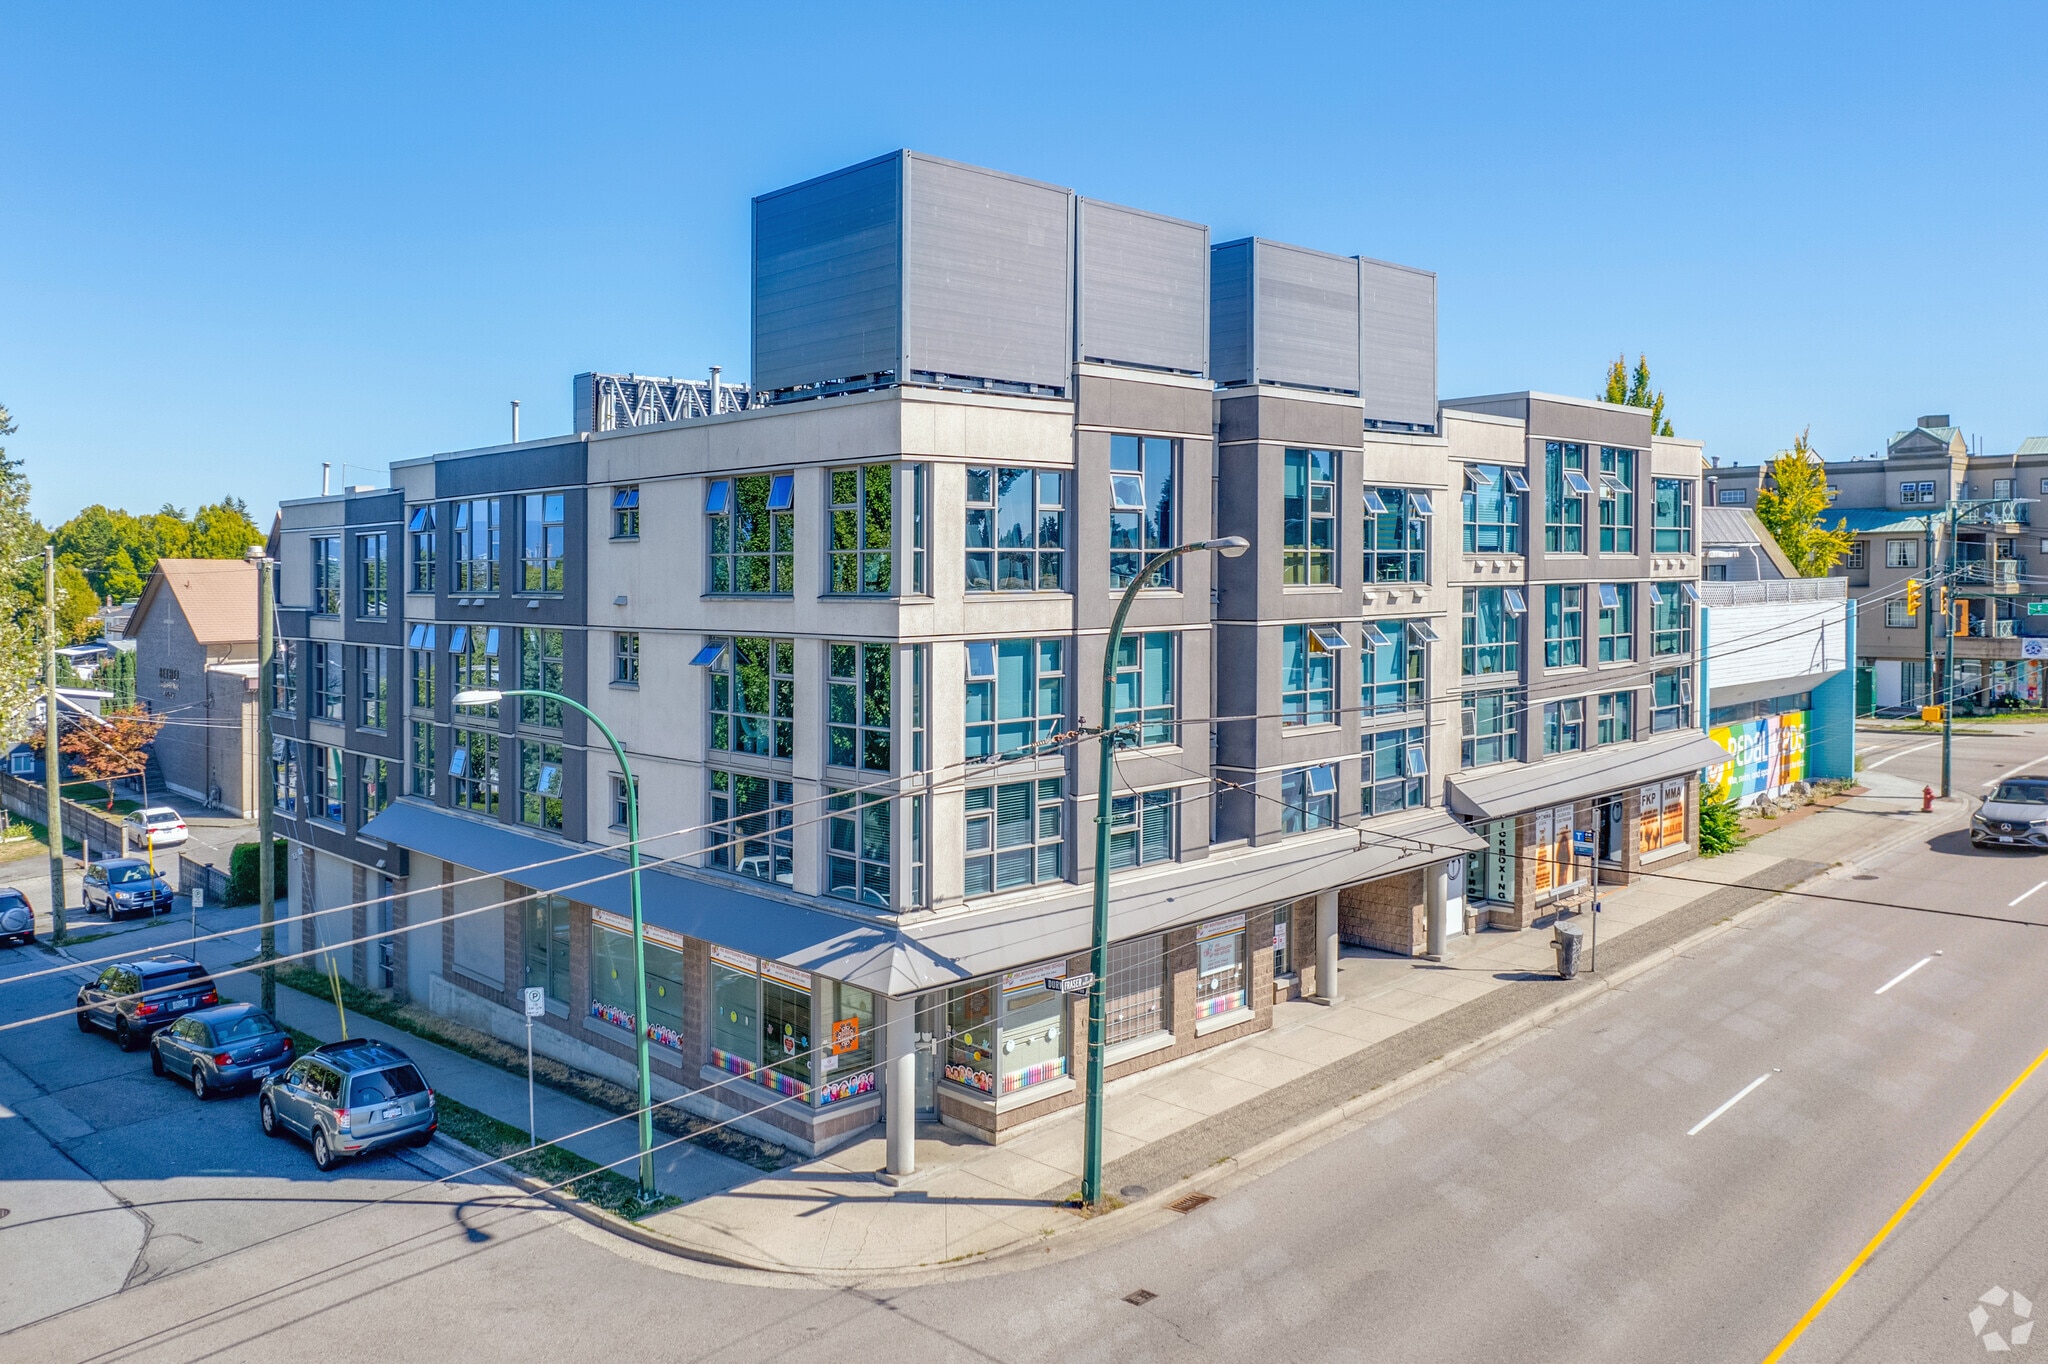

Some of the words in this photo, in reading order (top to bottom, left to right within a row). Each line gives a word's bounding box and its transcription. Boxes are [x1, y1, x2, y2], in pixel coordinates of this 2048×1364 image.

[1642, 792, 1656, 806] FKP
[1664, 786, 1682, 800] MMA
[1575, 832, 1582, 841] T
[1498, 822, 1507, 899] ICKBOXING
[1064, 978, 1082, 991] FRASER
